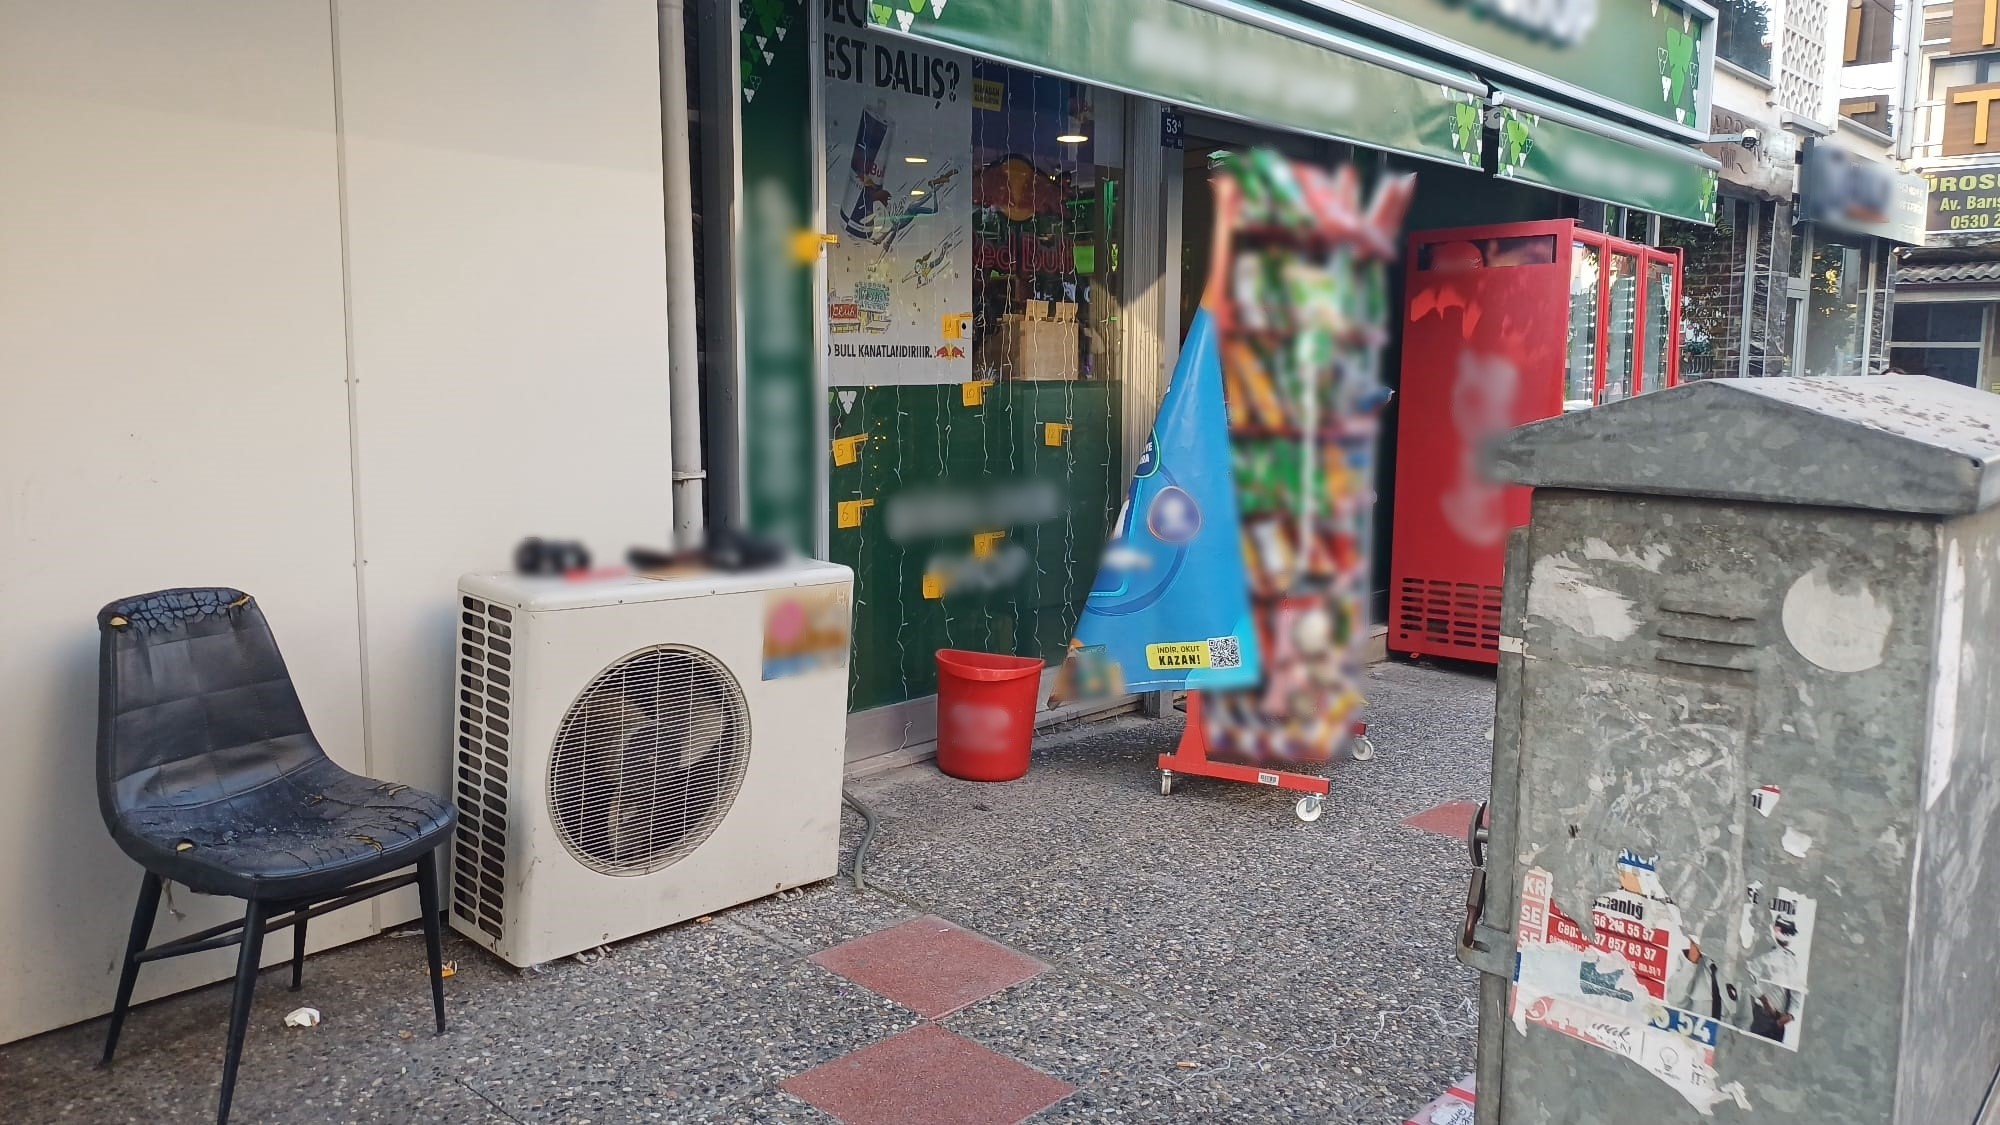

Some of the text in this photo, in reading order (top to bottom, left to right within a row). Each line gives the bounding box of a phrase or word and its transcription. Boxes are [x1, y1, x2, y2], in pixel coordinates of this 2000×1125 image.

[874, 45, 960, 110] DALIŞ?
[1940, 197, 1961, 211] Av.
[1950, 213, 1989, 230] 0530
[834, 343, 857, 358] BULL
[1158, 655, 1201, 666] KAZAN!
[1627, 923, 1641, 939] 55
[1608, 936, 1627, 952] 857
